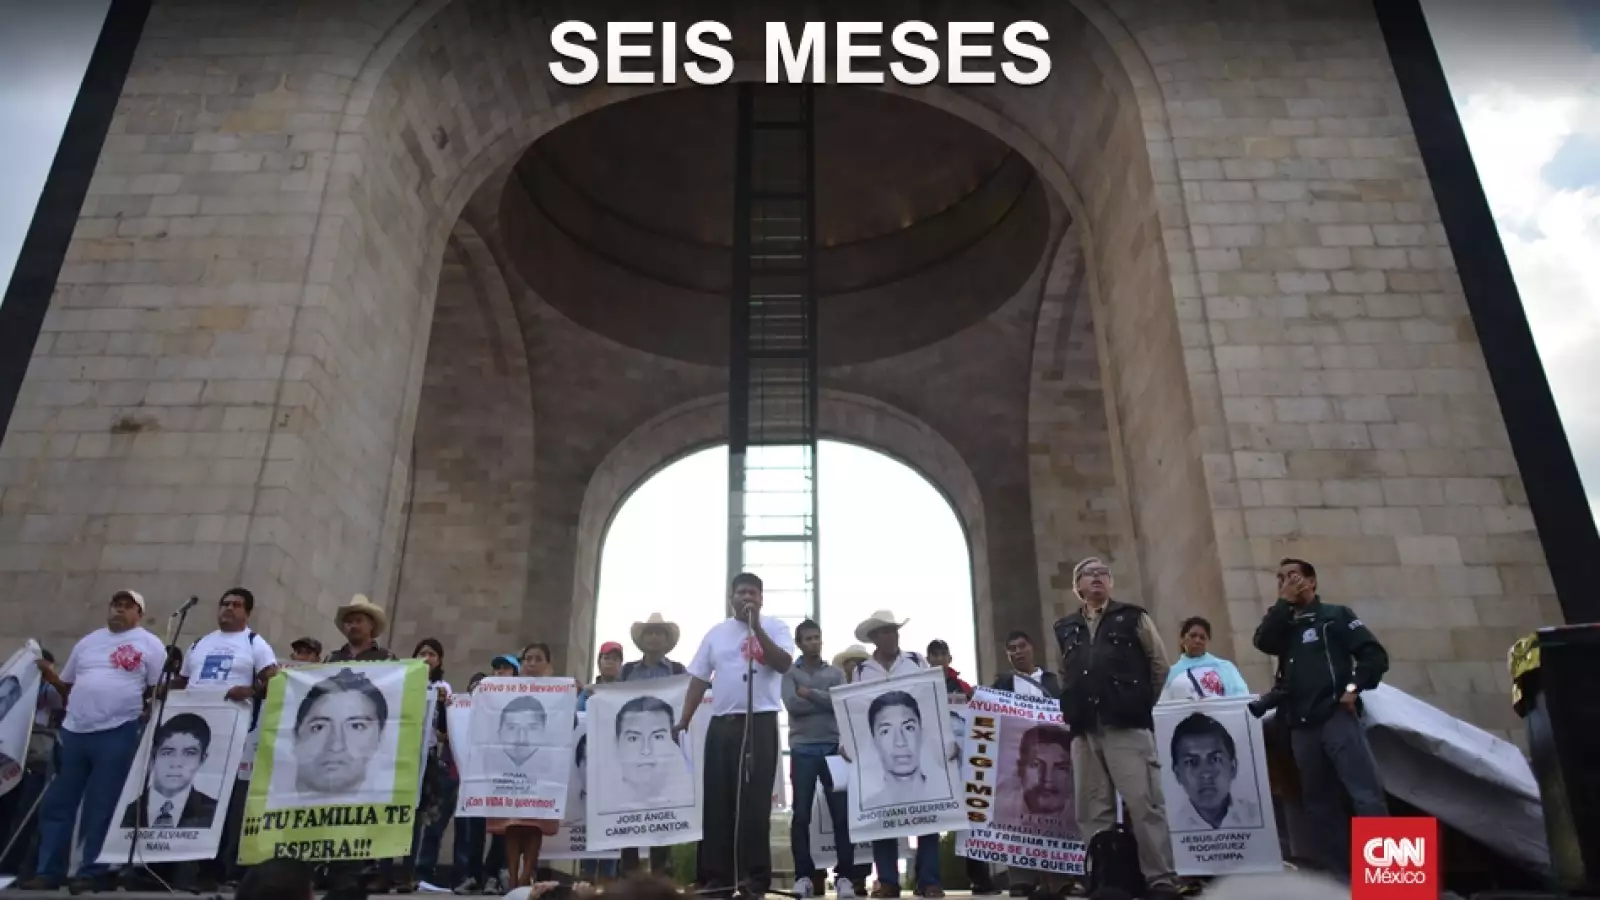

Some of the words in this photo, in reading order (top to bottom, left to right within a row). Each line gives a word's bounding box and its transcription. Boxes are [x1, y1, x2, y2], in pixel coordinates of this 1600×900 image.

[968, 700, 1034, 719] AYUDANOS
[1037, 711, 1046, 721] A
[965, 716, 997, 823] EXIGIMOS
[908, 801, 960, 815] GUERRERO
[292, 804, 379, 830] FAMILIA
[385, 805, 411, 825] TE
[616, 813, 642, 825] JOSE
[644, 811, 678, 822] ANGEL
[883, 820, 897, 829] DE
[899, 818, 911, 827] LA
[911, 815, 938, 825] CRUZ
[157, 830, 200, 840] ALVAREZ
[605, 824, 648, 837] CAMPOS
[145, 842, 171, 852] NAVA
[275, 838, 372, 860] ESPERA!!!
[1007, 844, 1023, 856] SE
[1026, 847, 1049, 859] LOS
[1188, 842, 1246, 853] RODRIGUEZ
[1012, 854, 1038, 868] LOS
[1195, 852, 1245, 863] TLATEMPA
